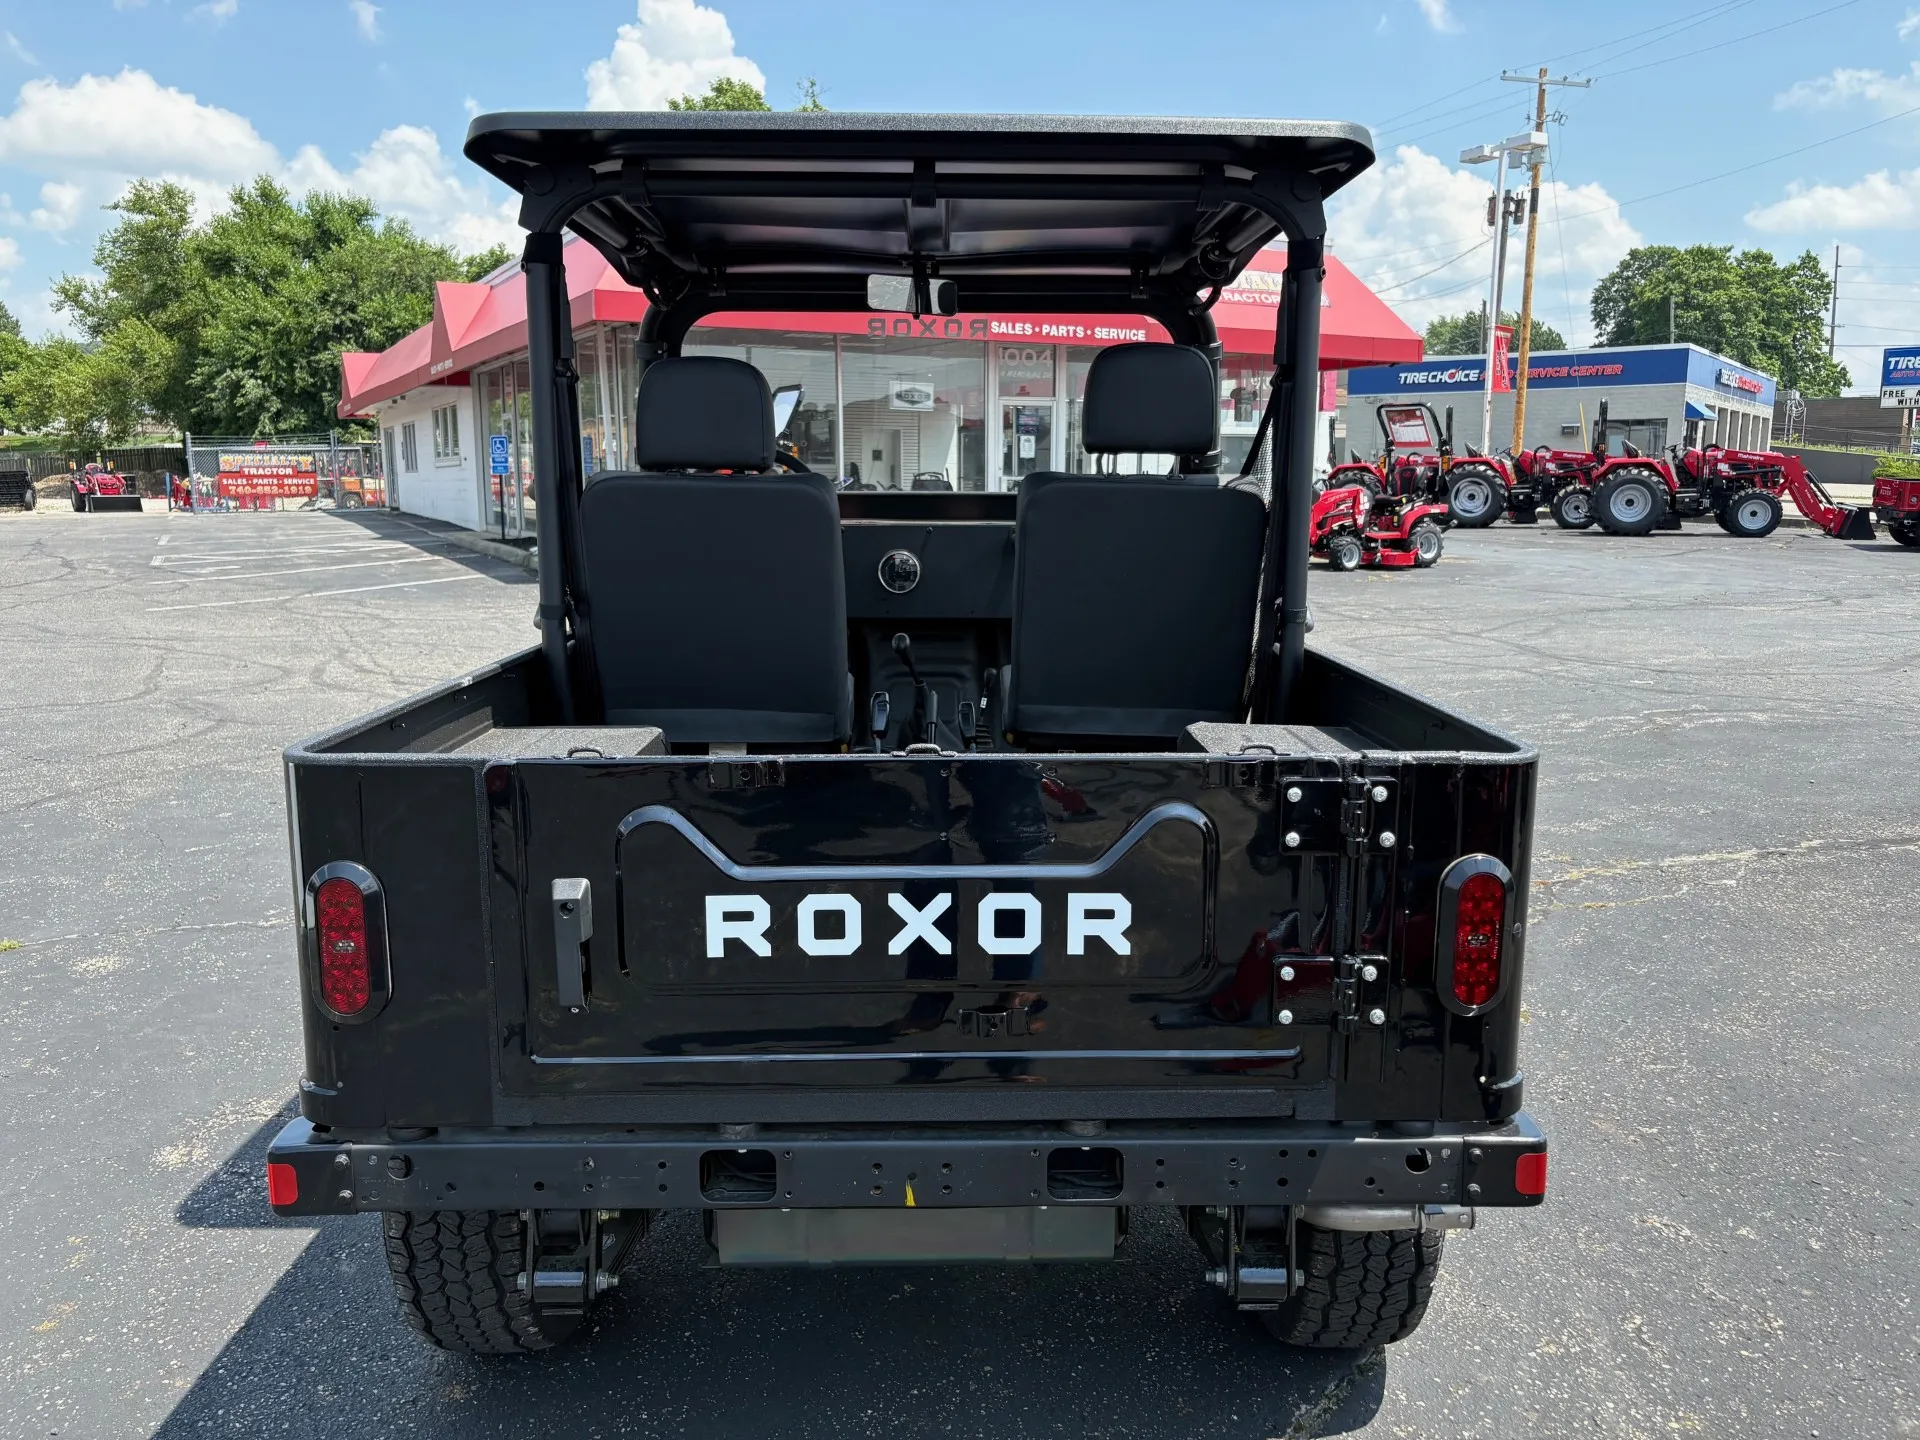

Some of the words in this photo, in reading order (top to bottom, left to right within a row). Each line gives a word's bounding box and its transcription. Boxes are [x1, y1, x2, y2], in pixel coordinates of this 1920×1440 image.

[1221, 290, 1281, 303] RACTOR
[990, 320, 1033, 335] SALES
[1041, 323, 1085, 338] PARTS
[1094, 327, 1147, 341] SERVICE
[1570, 364, 1623, 376] CENTER
[1890, 370, 1915, 378] AUTO
[1883, 390, 1905, 398] FREE
[1897, 398, 1919, 406] WITH
[220, 455, 313, 471] SPECIALTY
[243, 467, 293, 475] TRACTOR
[705, 892, 1132, 958] ROXOR
